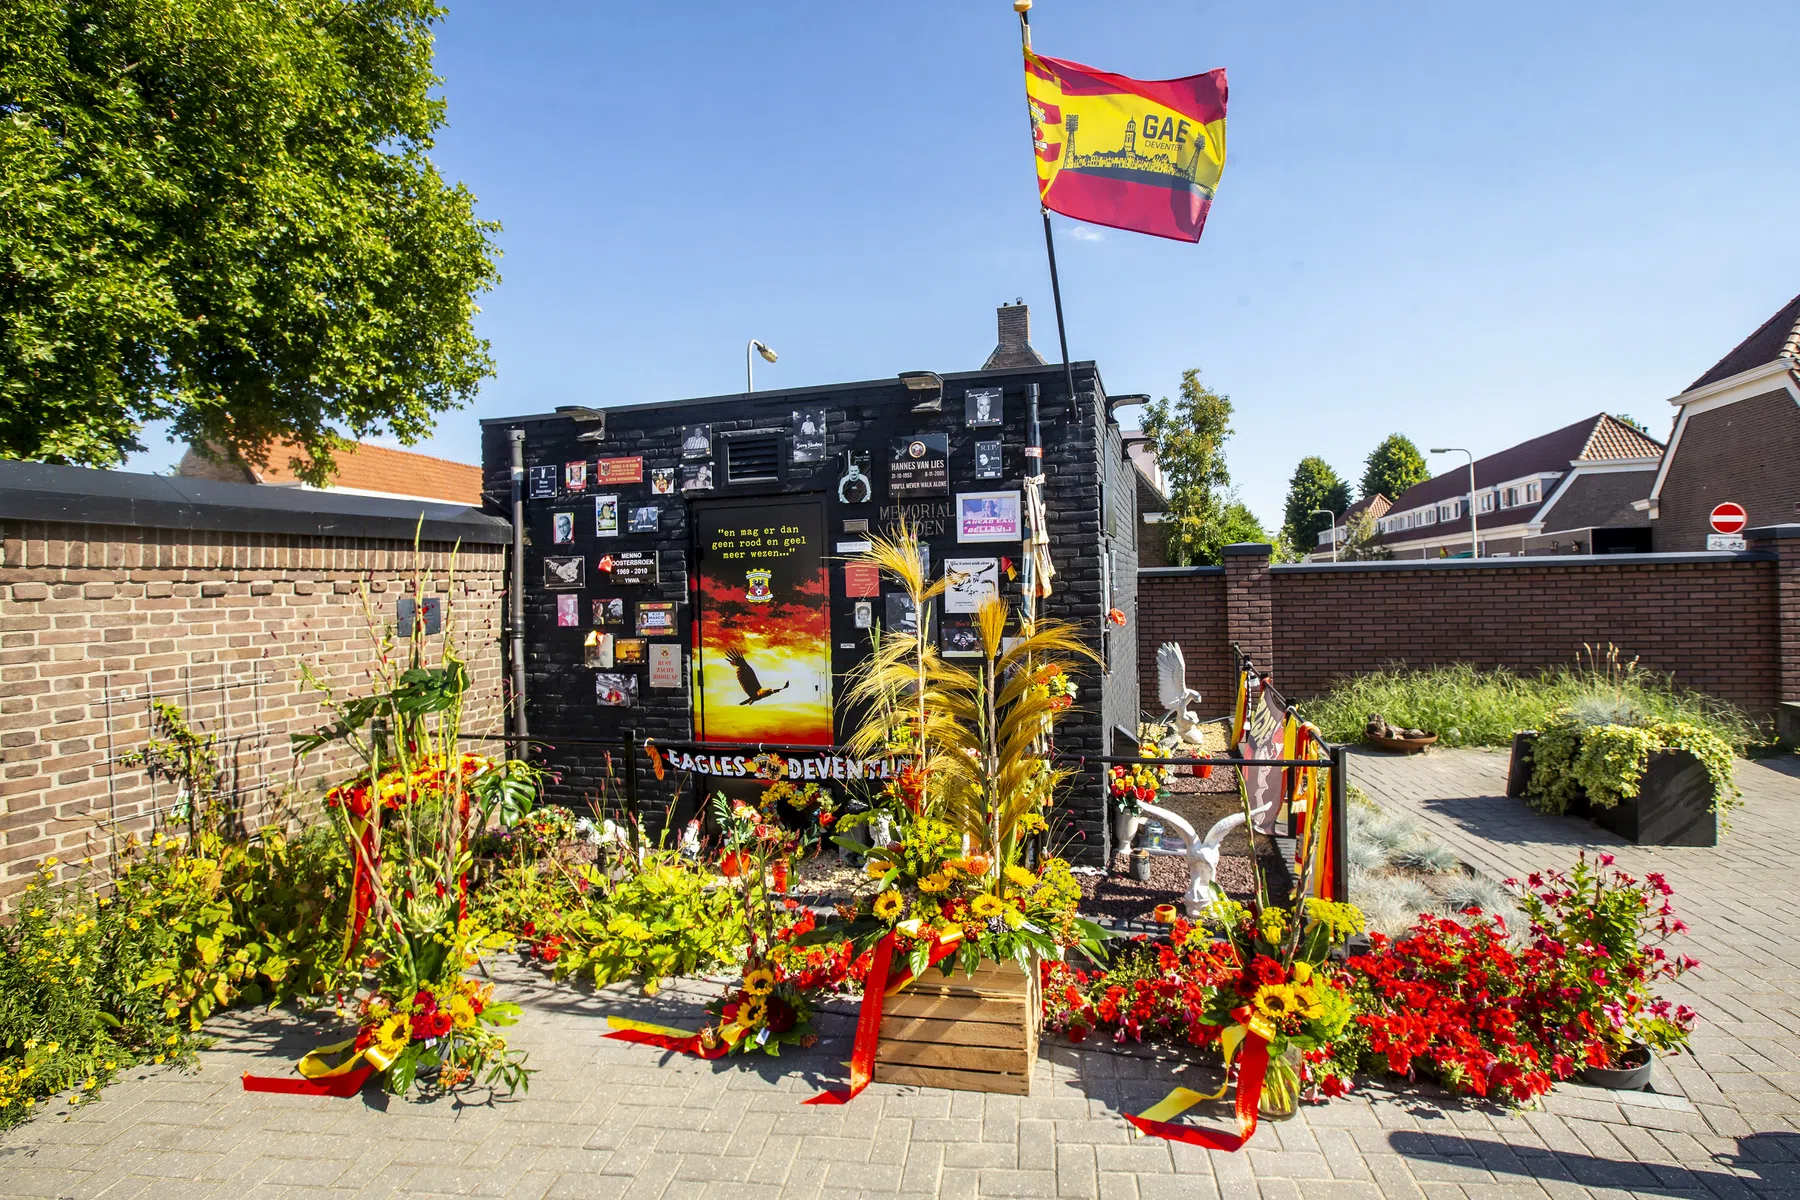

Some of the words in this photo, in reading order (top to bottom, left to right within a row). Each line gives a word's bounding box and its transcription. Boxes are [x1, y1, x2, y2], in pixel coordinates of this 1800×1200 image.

[1143, 114, 1191, 143] GAE
[1145, 140, 1183, 152] DEVENTER
[891, 462, 915, 471] HANNES
[917, 461, 930, 469] VAN
[930, 460, 945, 468] LIES
[891, 482, 905, 490] YOU'LL
[879, 502, 955, 520] MEMORIAL
[717, 528, 736, 537] "en
[740, 528, 759, 537] mag
[763, 527, 776, 535] er
[780, 525, 799, 534] dan
[712, 540, 734, 550] geen
[739, 538, 762, 547] rood
[783, 536, 807, 547] geel
[723, 551, 746, 559] meer
[750, 547, 796, 558] wezen..."
[611, 559, 655, 567] OOSTERBROEK
[633, 567, 648, 575] 2010
[667, 749, 747, 777] EAGLES
